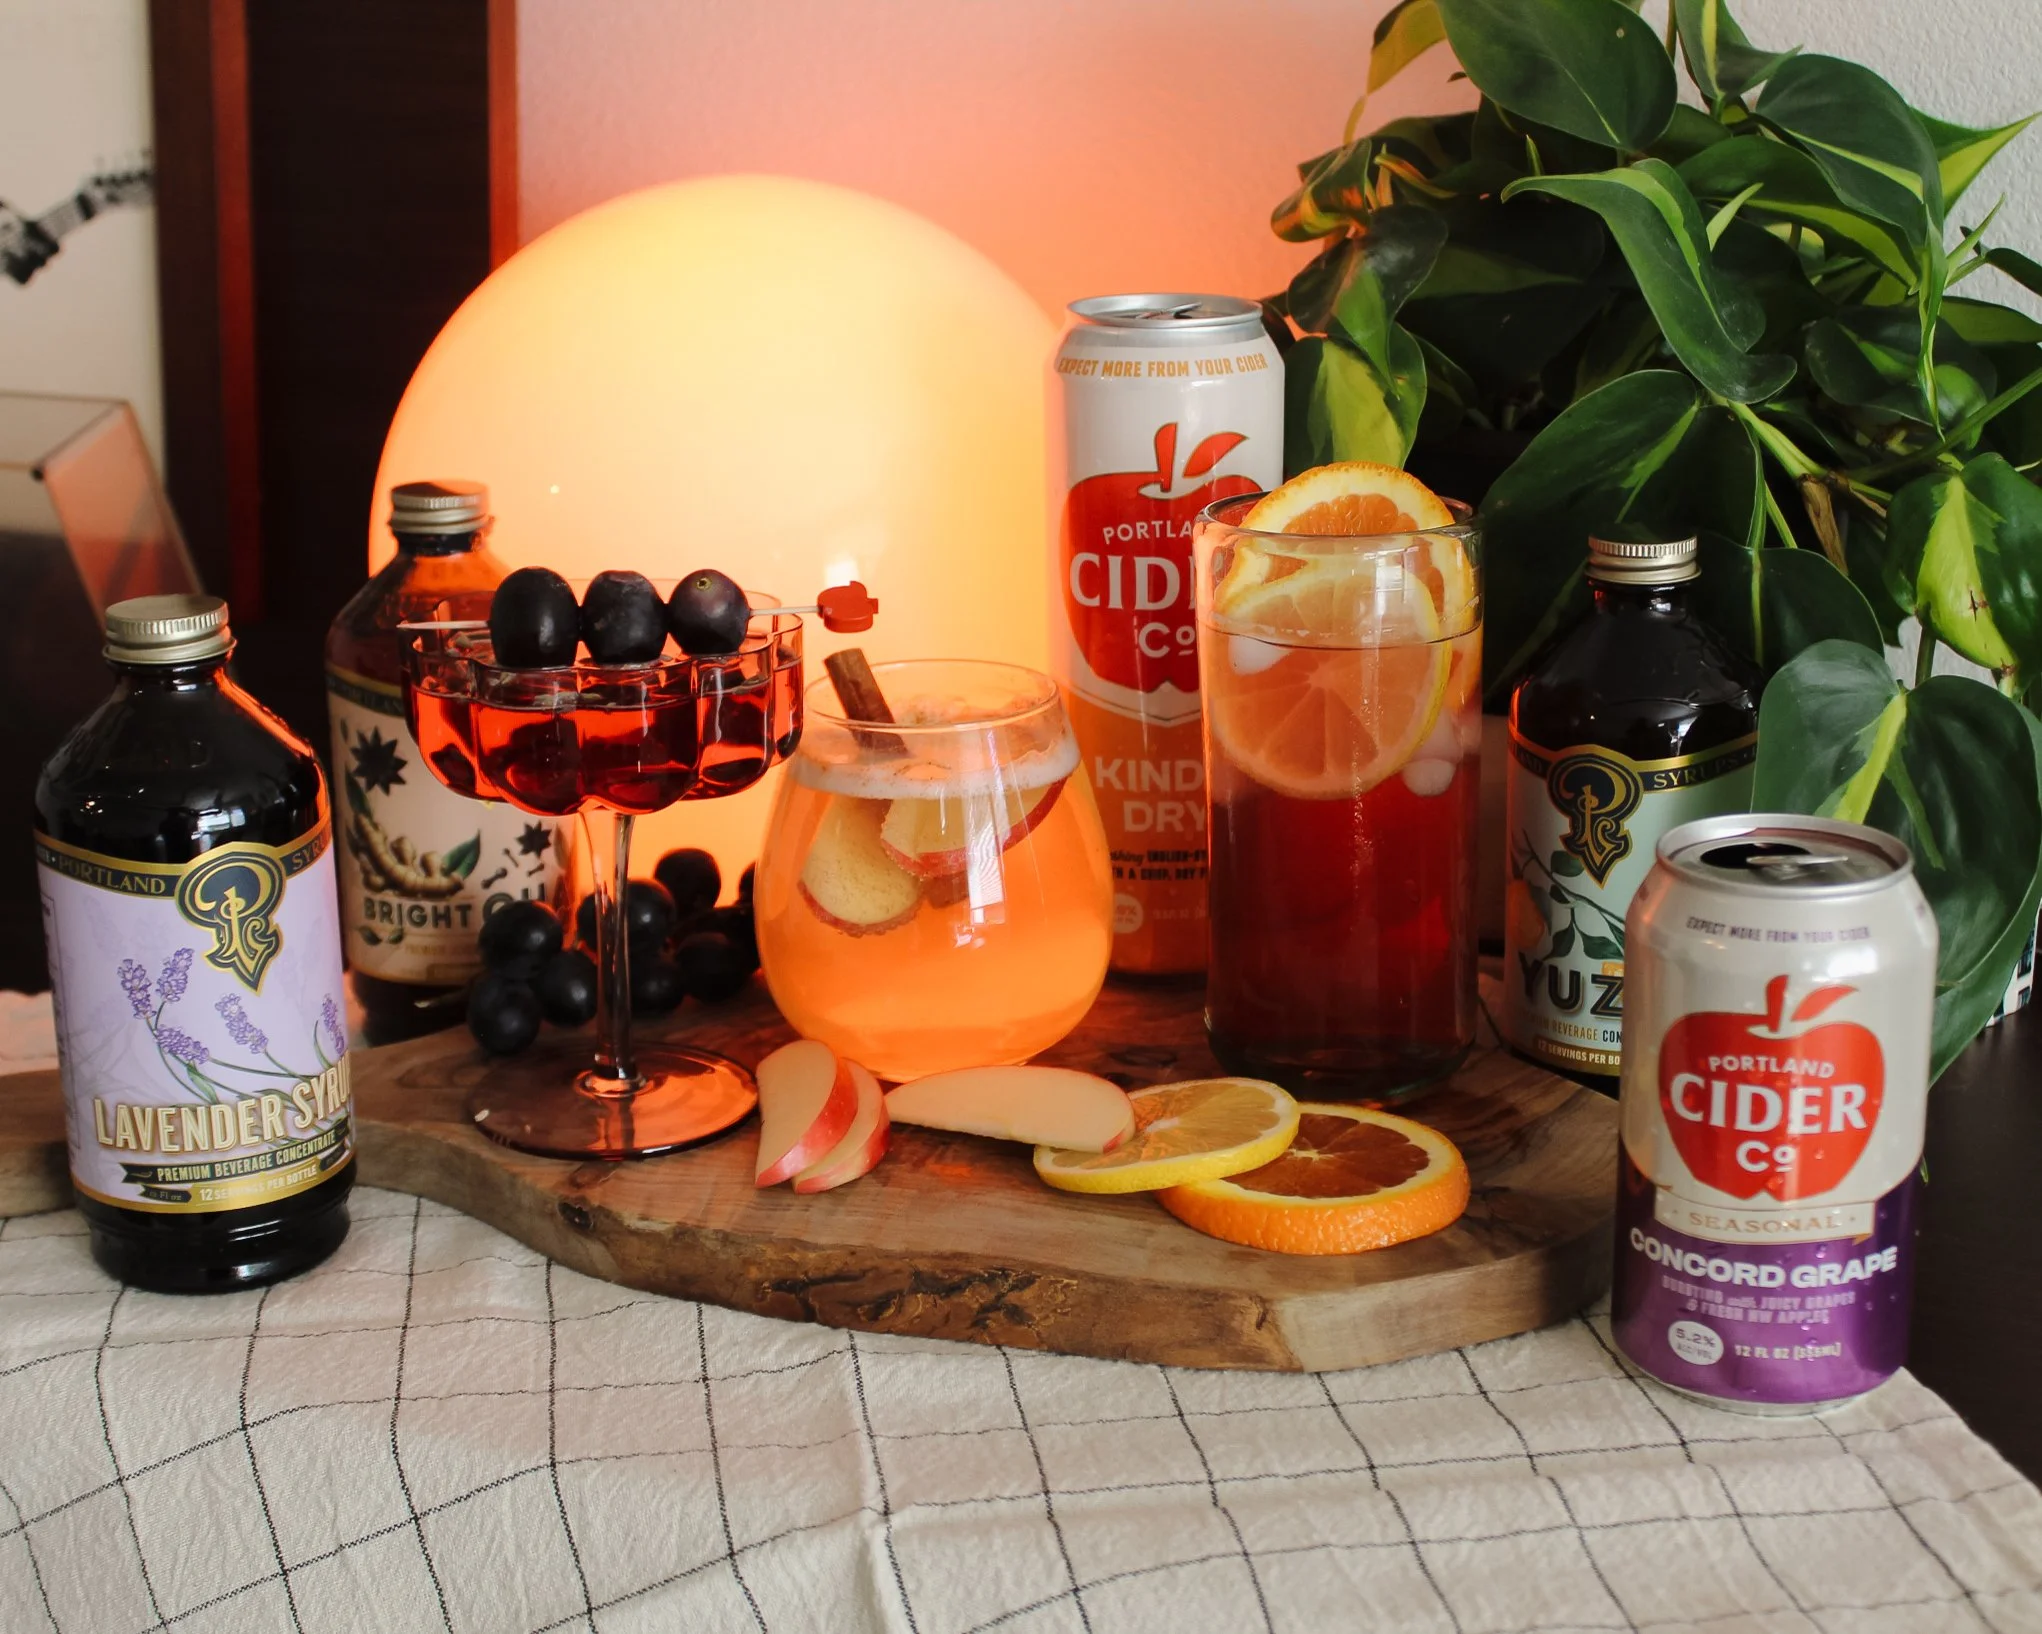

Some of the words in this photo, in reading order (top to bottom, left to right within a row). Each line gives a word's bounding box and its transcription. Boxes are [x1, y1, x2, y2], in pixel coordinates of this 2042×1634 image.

[1056, 356, 1099, 377] EXPECT
[1101, 359, 1142, 377] MORE
[1147, 360, 1190, 378] FROM
[1195, 357, 1233, 376] YOUR
[1236, 353, 1268, 373] CIDER
[1069, 551, 1196, 611] CID
[1122, 800, 1207, 833] DRY
[58, 856, 167, 895] PORTLAND
[363, 896, 472, 930] BRIGHT
[1686, 916, 1726, 936] EXPECT
[1729, 926, 1763, 943] MORE
[1767, 929, 1799, 943] FROM
[1552, 1019, 1599, 1041] BEVERAGE
[1548, 1043, 1588, 1062] SERVINGS
[1589, 1052, 1607, 1064] PER
[1708, 1055, 1836, 1079] PORTLAND
[1669, 1072, 1868, 1136] CIDER
[94, 1093, 285, 1154] LAVENDER
[156, 1164, 212, 1182] PREMIUM
[214, 1158, 274, 1178] BEVERAGE
[275, 1129, 337, 1169] CONCENTRATE
[199, 1187, 214, 1201] 12
[267, 1179, 286, 1191] PER
[286, 1166, 318, 1186] BOTTLE
[1689, 1212, 1842, 1234] SEASONAL
[1630, 1226, 1787, 1289] CONCORD
[1790, 1245, 1899, 1289] GRAPE
[1701, 1301, 1744, 1321] FRESH
[1777, 1308, 1830, 1325] APPLES
[1805, 1290, 1856, 1310] GRAPES
[1675, 1327, 1716, 1348] 5.2%
[1734, 1343, 1752, 1358] 12
